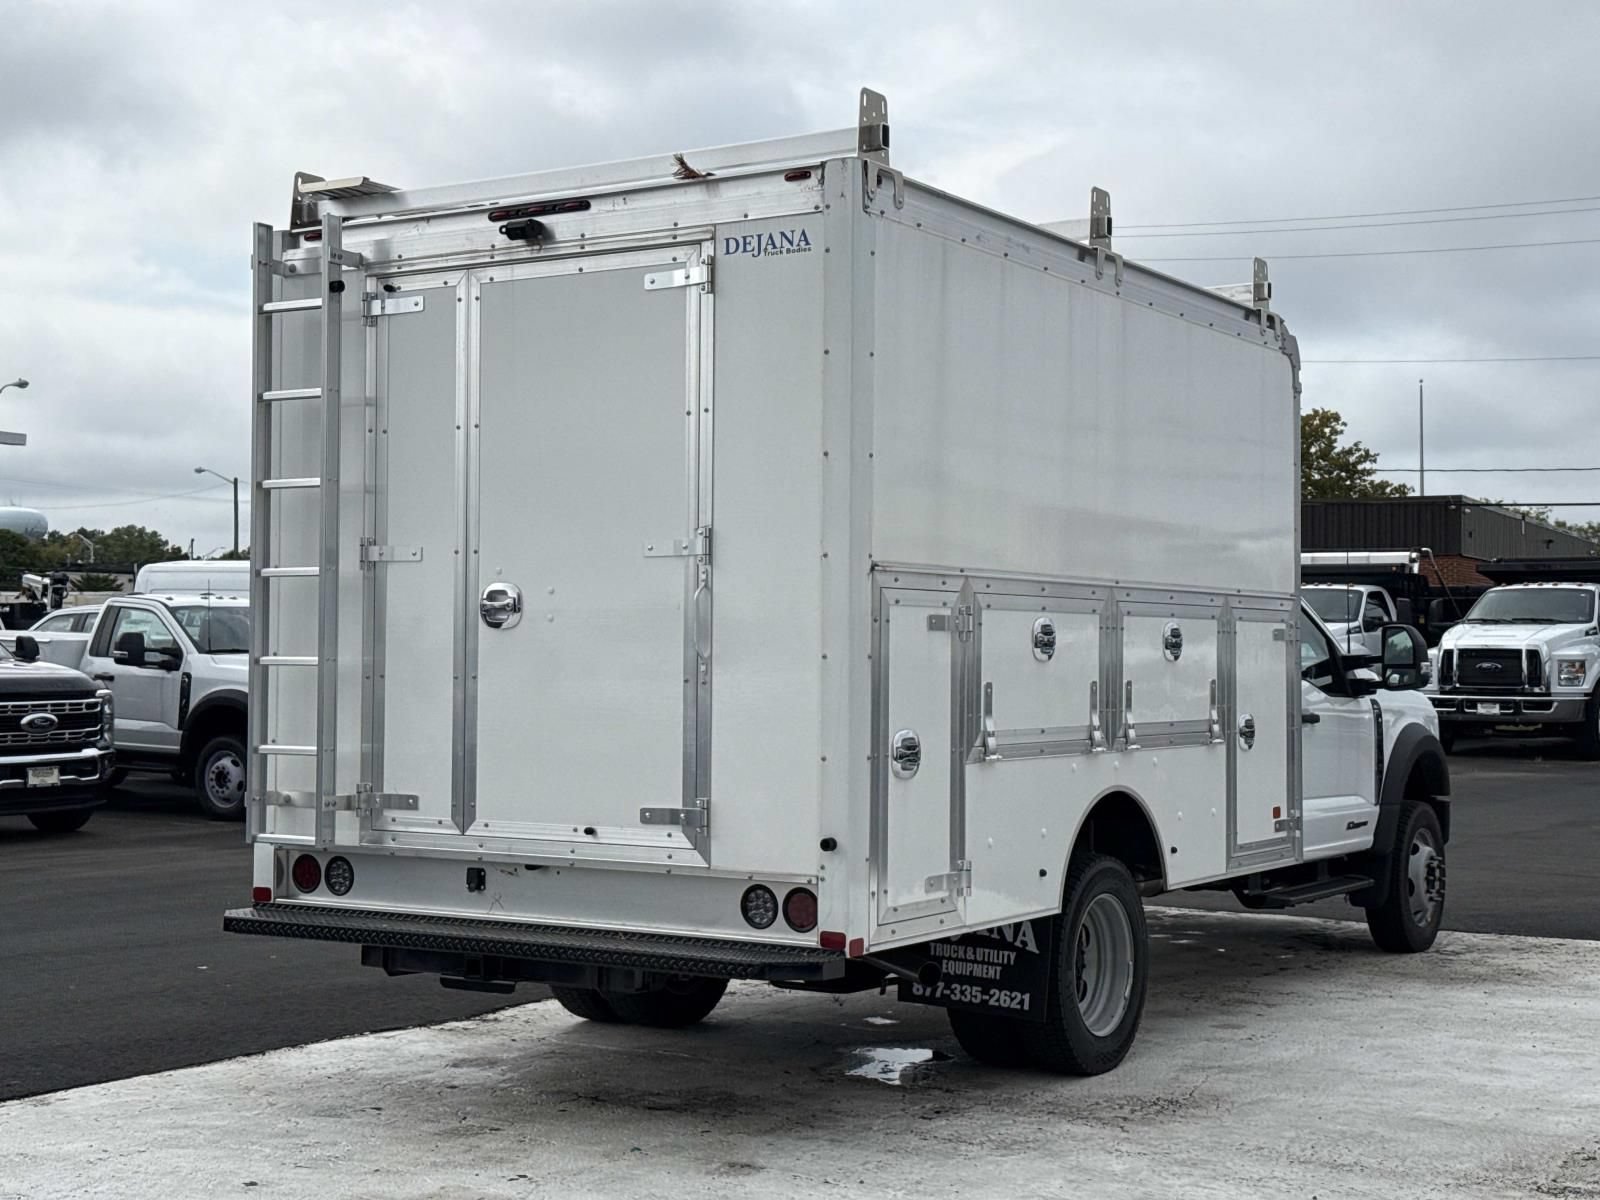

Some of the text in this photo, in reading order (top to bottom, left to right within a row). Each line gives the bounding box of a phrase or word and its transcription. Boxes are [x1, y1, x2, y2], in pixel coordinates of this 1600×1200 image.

[724, 228, 811, 258] DEJANA
[763, 247, 812, 257] Truck Bodies
[942, 960, 1002, 980] EQUIPMENT
